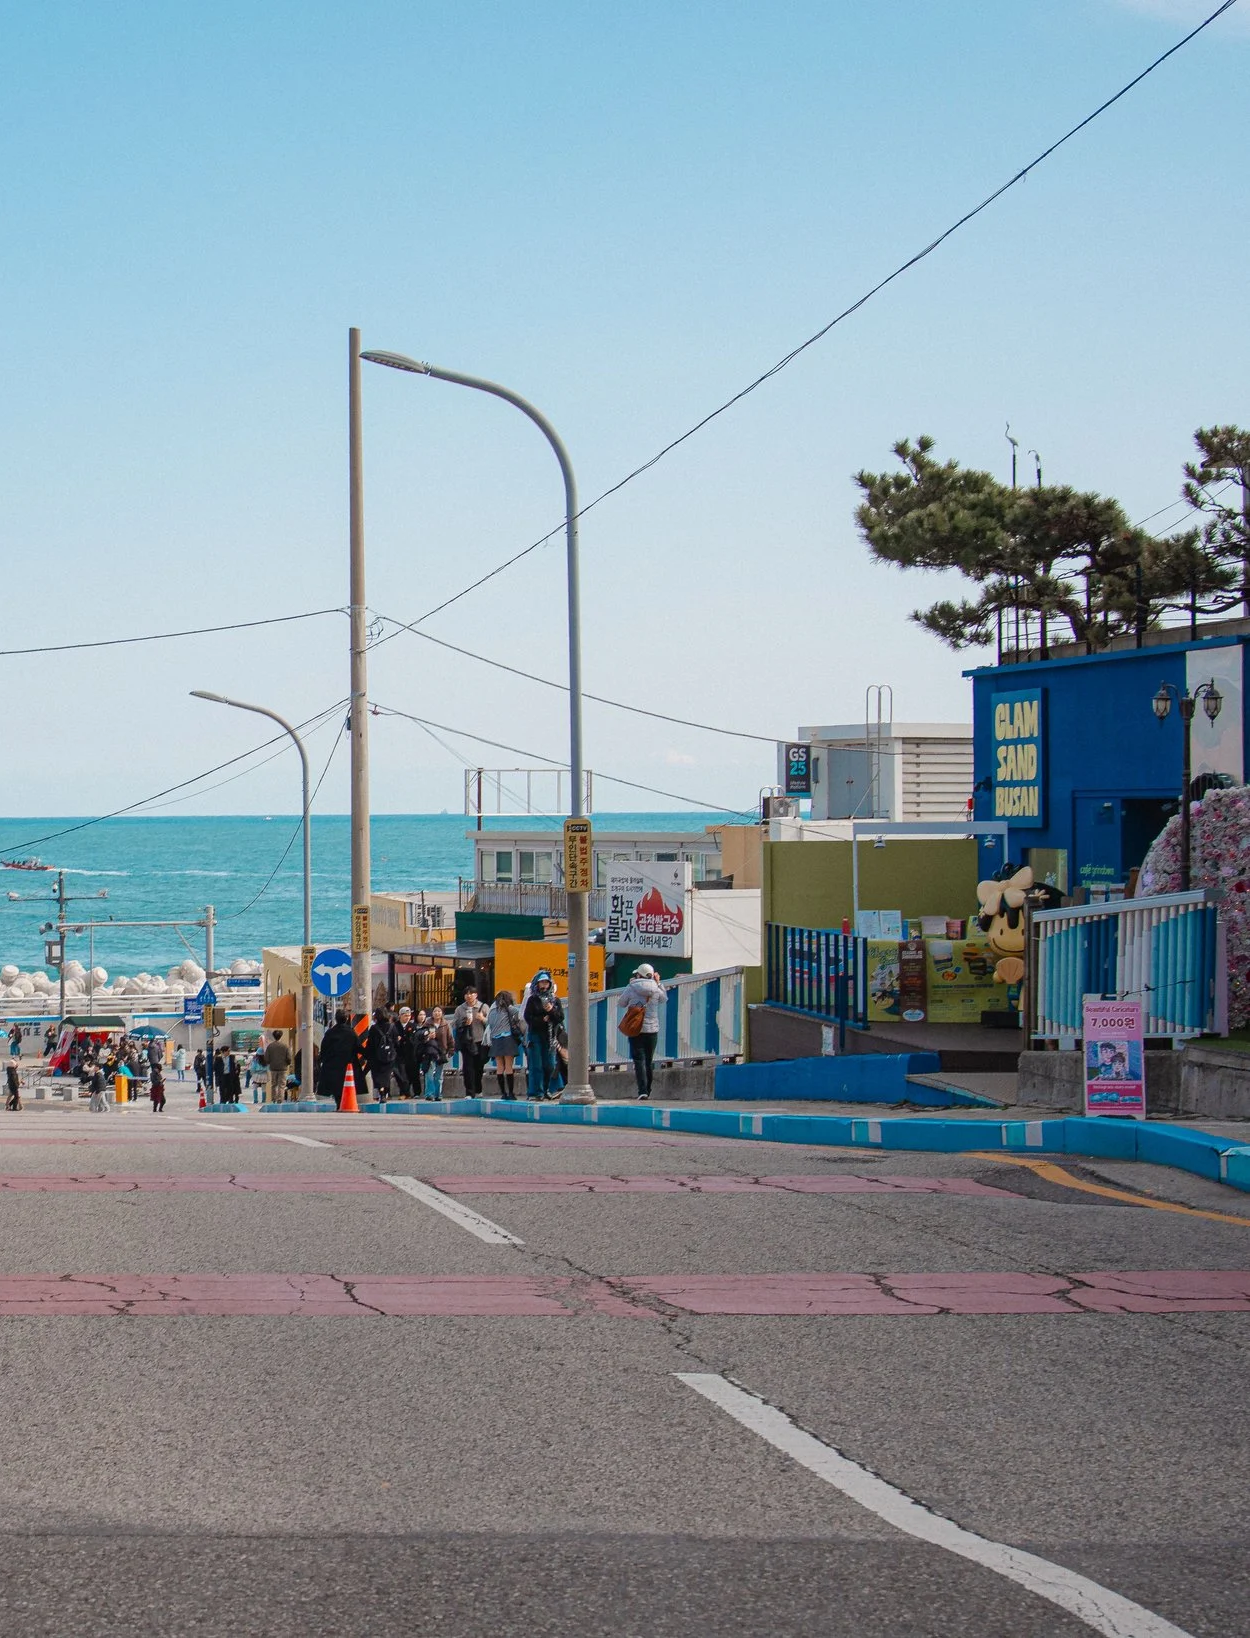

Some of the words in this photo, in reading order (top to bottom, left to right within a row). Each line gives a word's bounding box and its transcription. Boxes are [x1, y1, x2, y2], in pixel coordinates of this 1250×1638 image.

[995, 701, 1039, 741] CLAM
[789, 747, 807, 761] GS
[996, 743, 1038, 782] SAND
[790, 761, 807, 775] 25
[995, 785, 1039, 817] BUSAN
[568, 835, 578, 888] 무인단속구간
[579, 835, 589, 888] 불법주정차
[611, 894, 634, 917] 화끈
[608, 915, 637, 942] 불맛!
[639, 913, 680, 933] 곱창쌀국수
[639, 935, 673, 948] 어떠세요?
[1091, 1017, 1135, 1029] 7,000원
